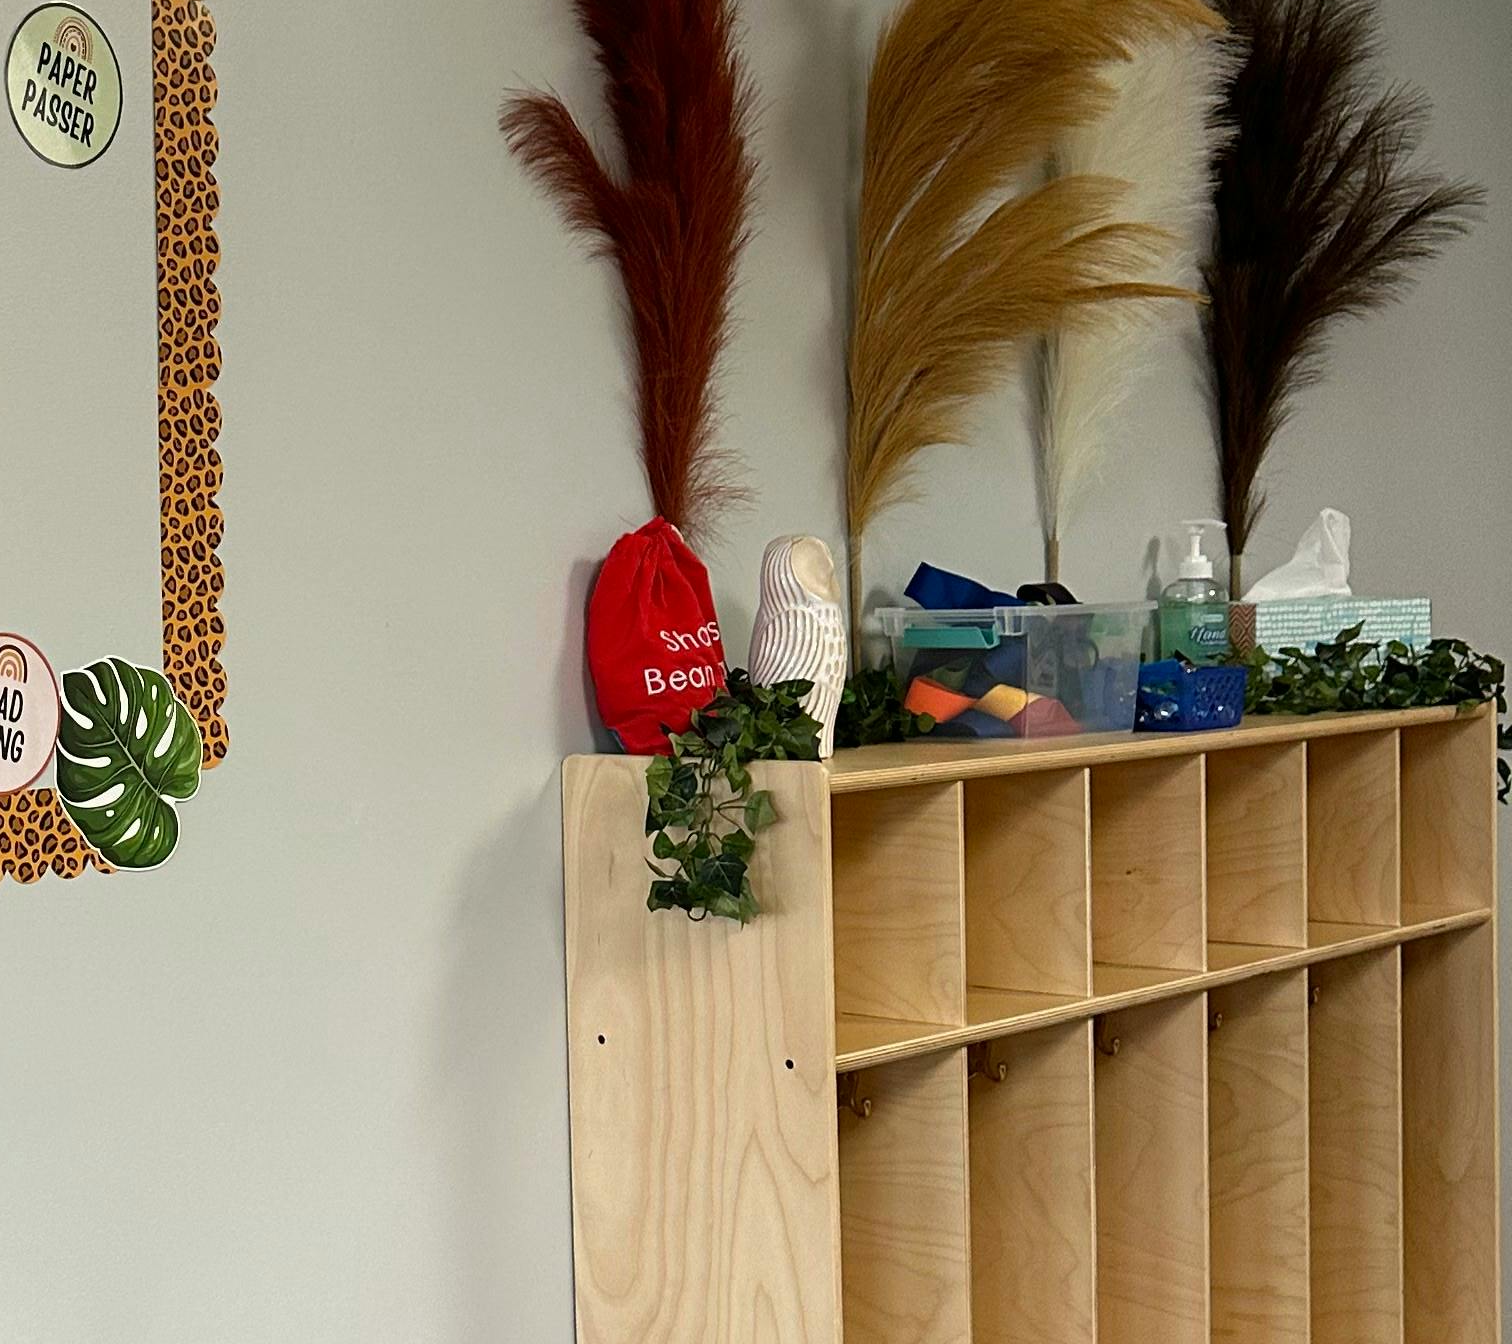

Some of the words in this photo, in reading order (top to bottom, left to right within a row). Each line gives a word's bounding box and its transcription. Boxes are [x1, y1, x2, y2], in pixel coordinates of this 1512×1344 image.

[37, 42, 96, 104] PAPER
[22, 79, 94, 147] PASSER
[644, 665, 716, 695] Bean
